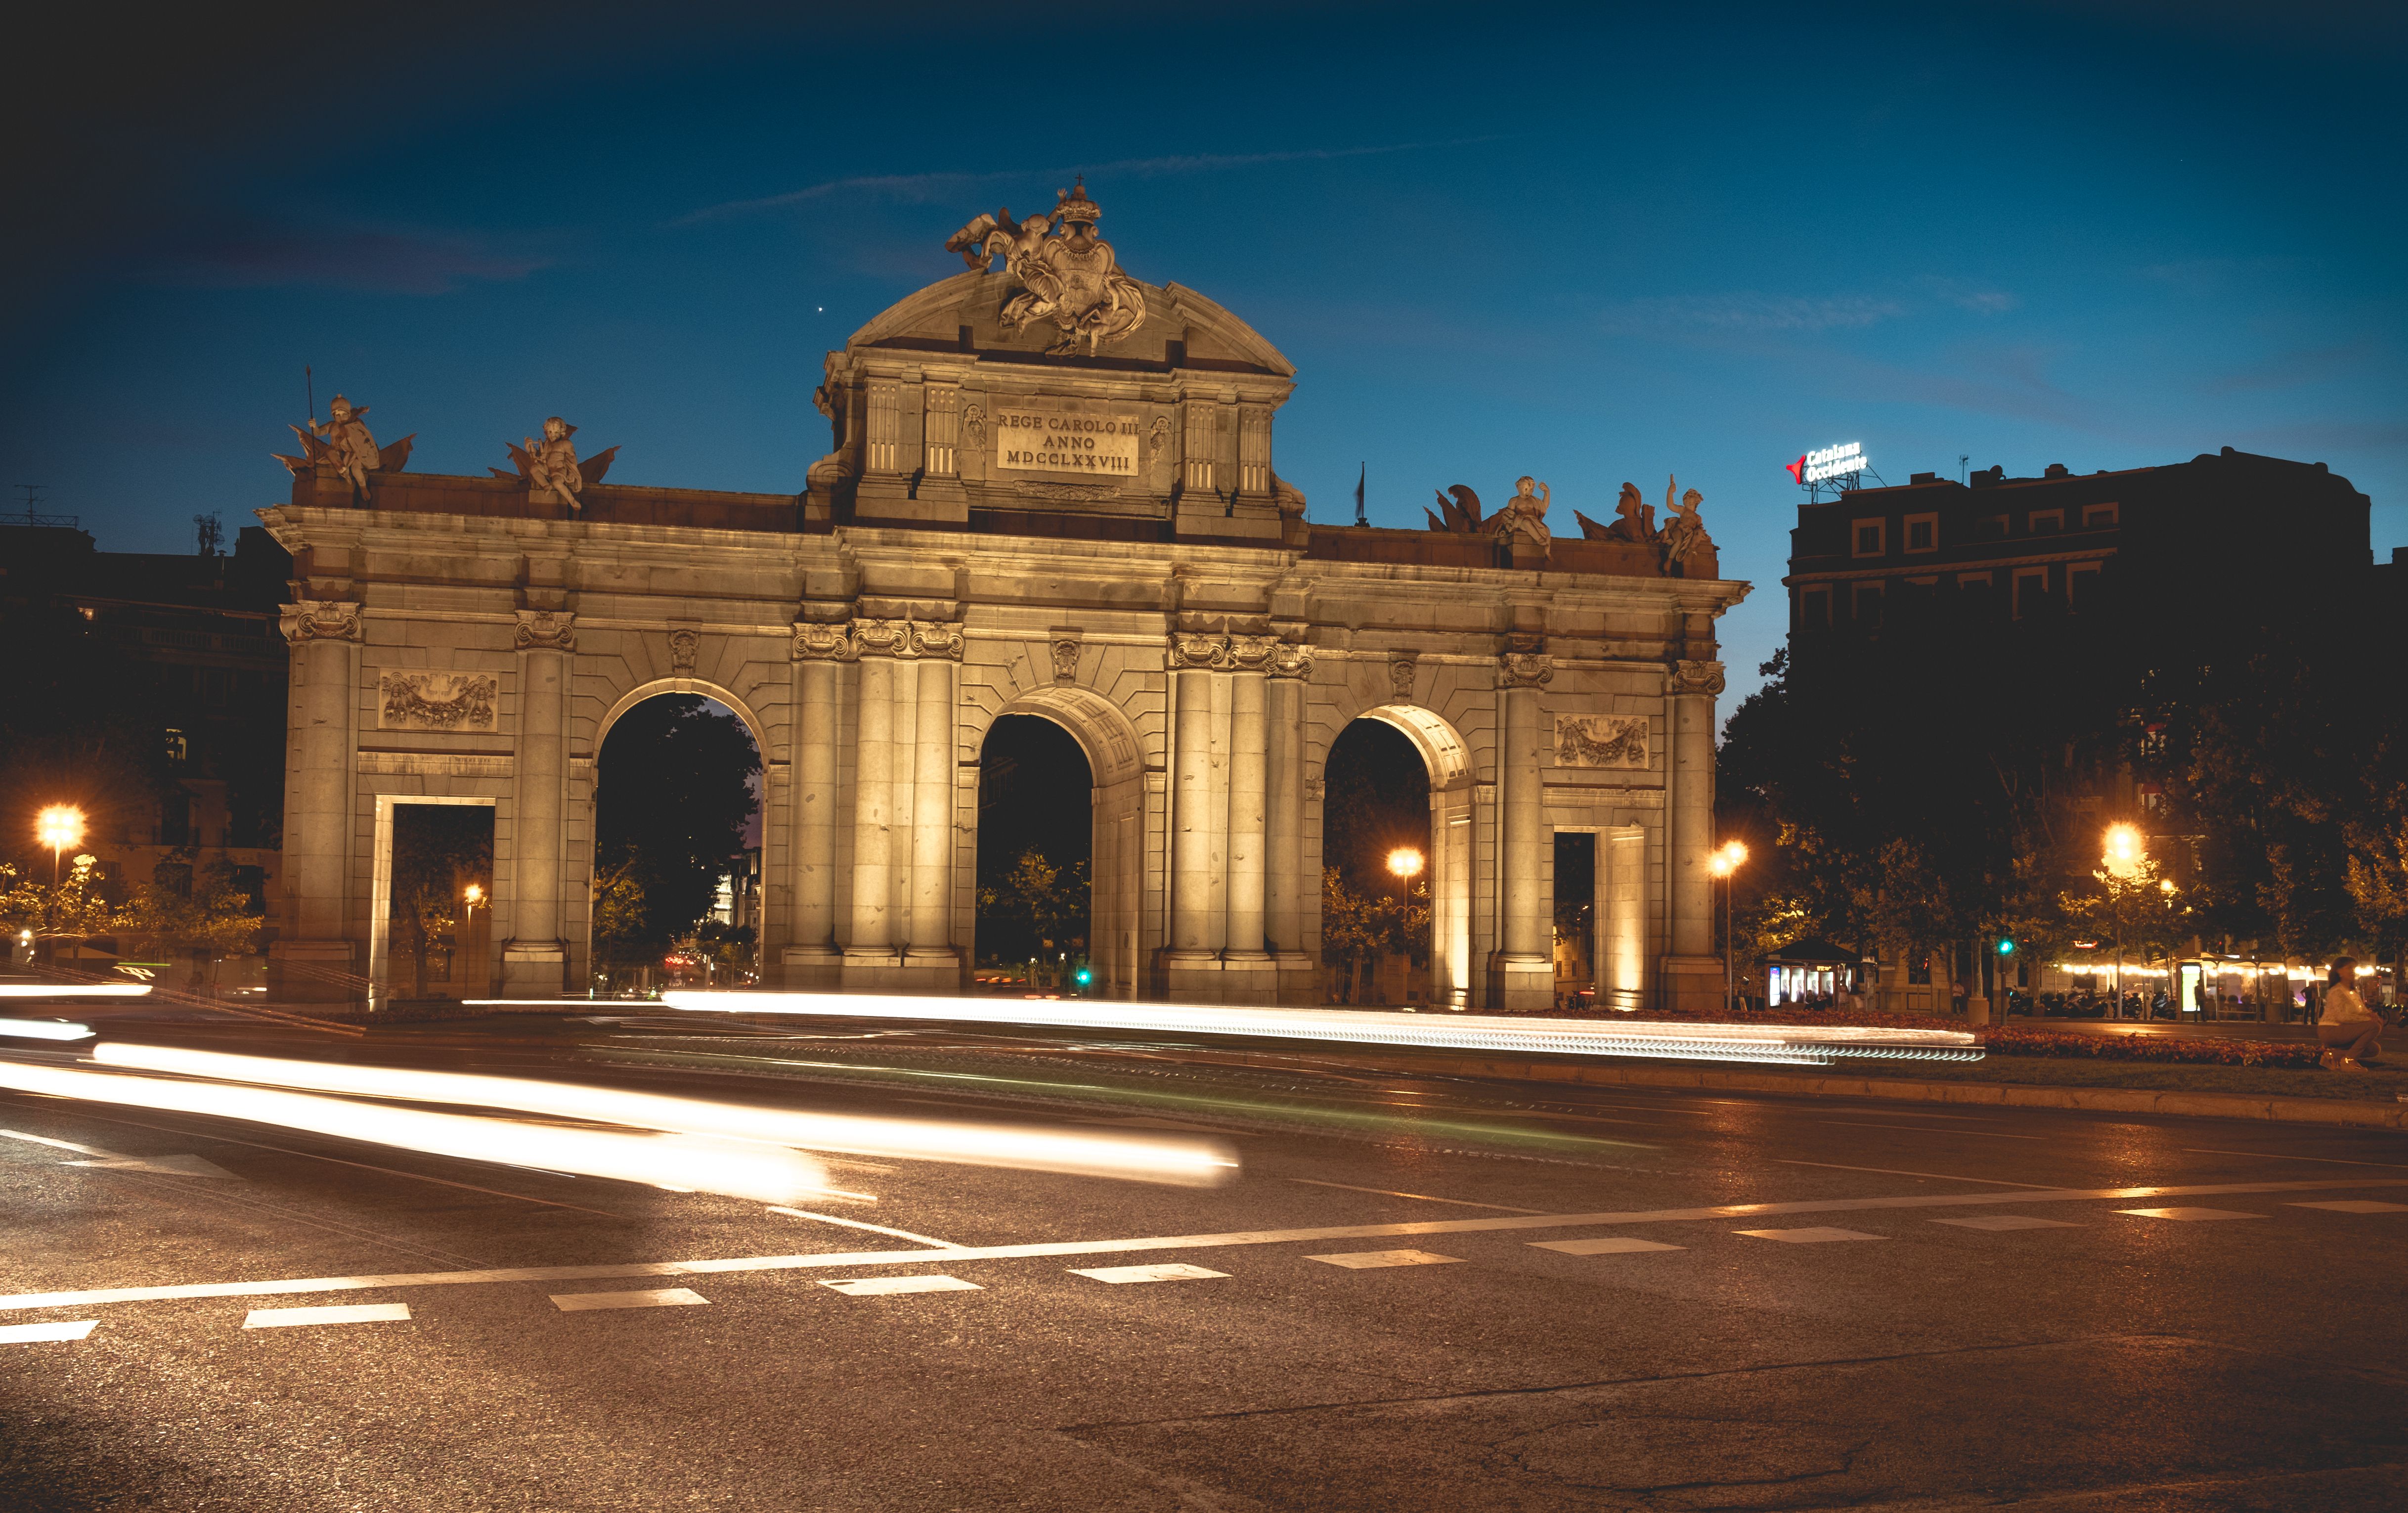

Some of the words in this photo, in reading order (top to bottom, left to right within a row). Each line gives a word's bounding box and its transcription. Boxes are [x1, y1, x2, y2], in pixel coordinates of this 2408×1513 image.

[998, 415, 1042, 428] REGE
[1048, 418, 1116, 433] CAROLO
[1121, 423, 1139, 434] III
[1043, 435, 1095, 448] ANNO
[1007, 450, 1129, 468] MDCCLXXVIII
[1807, 443, 1860, 466] Catalana
[1807, 456, 1867, 482] Occidente
